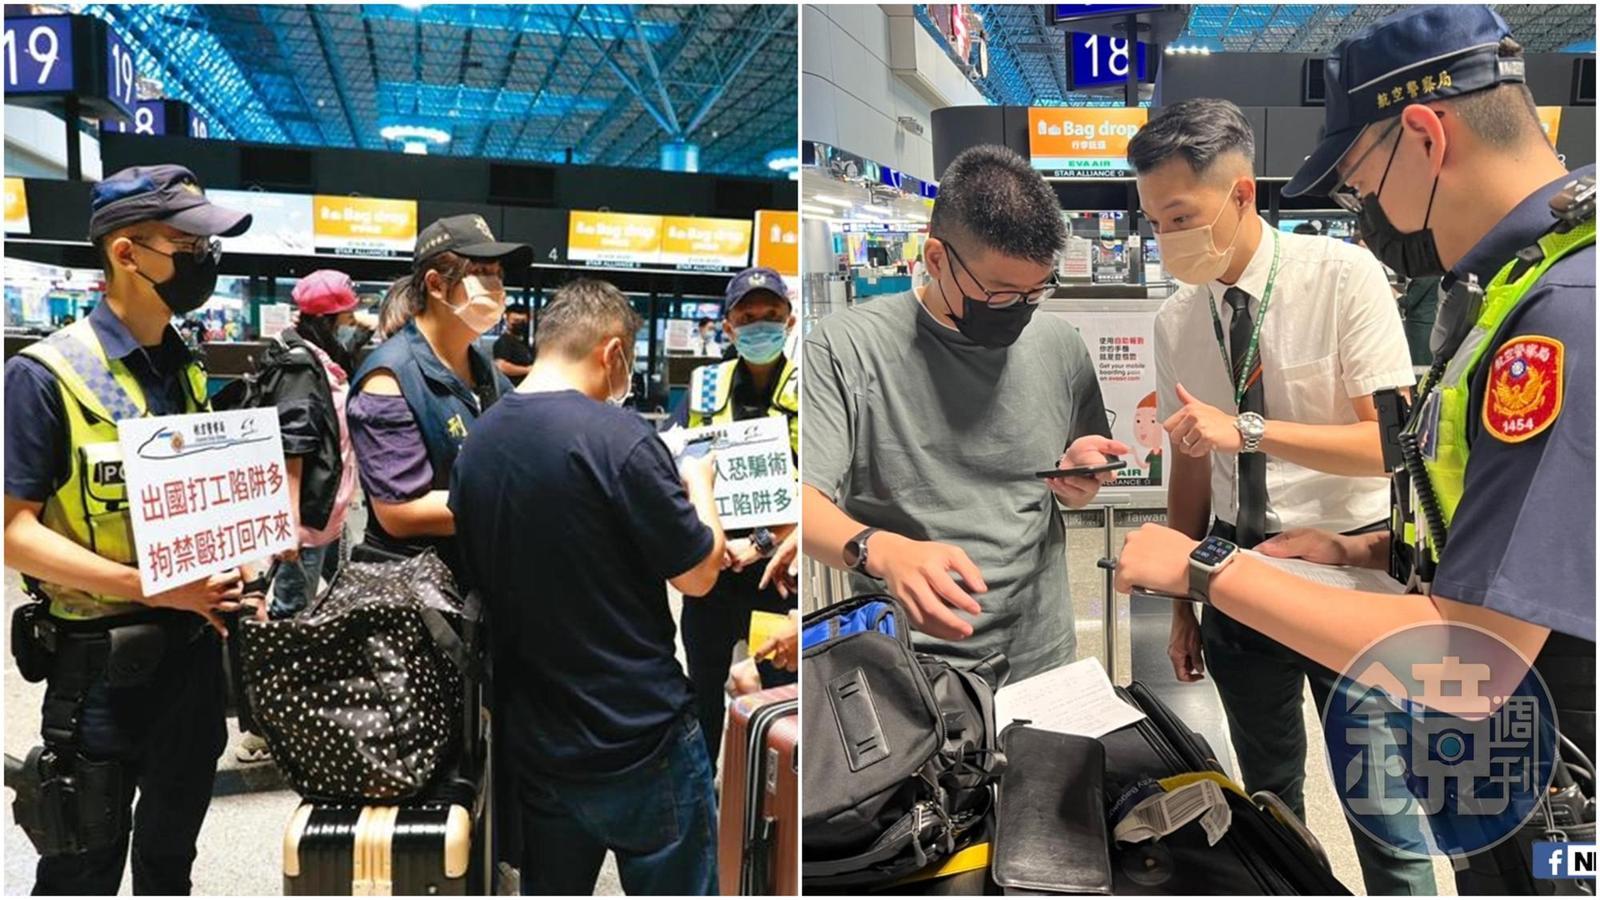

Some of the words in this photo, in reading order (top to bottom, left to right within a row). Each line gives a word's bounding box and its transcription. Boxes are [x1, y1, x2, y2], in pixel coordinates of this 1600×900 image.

[4, 26, 58, 85] 19
[112, 43, 133, 104] 19
[1084, 34, 1128, 77] 18
[1376, 70, 1452, 109] 航空警察局
[1063, 120, 1095, 139] Bag
[1098, 120, 1138, 139] drop
[1054, 169, 1075, 177] STAR
[1076, 169, 1115, 177] ALLIANCE
[548, 247, 558, 261] 4
[1503, 418, 1534, 433] 1454
[141, 462, 284, 522] 出國打工陷阱多
[148, 509, 292, 582] 拘禁毆打回不來
